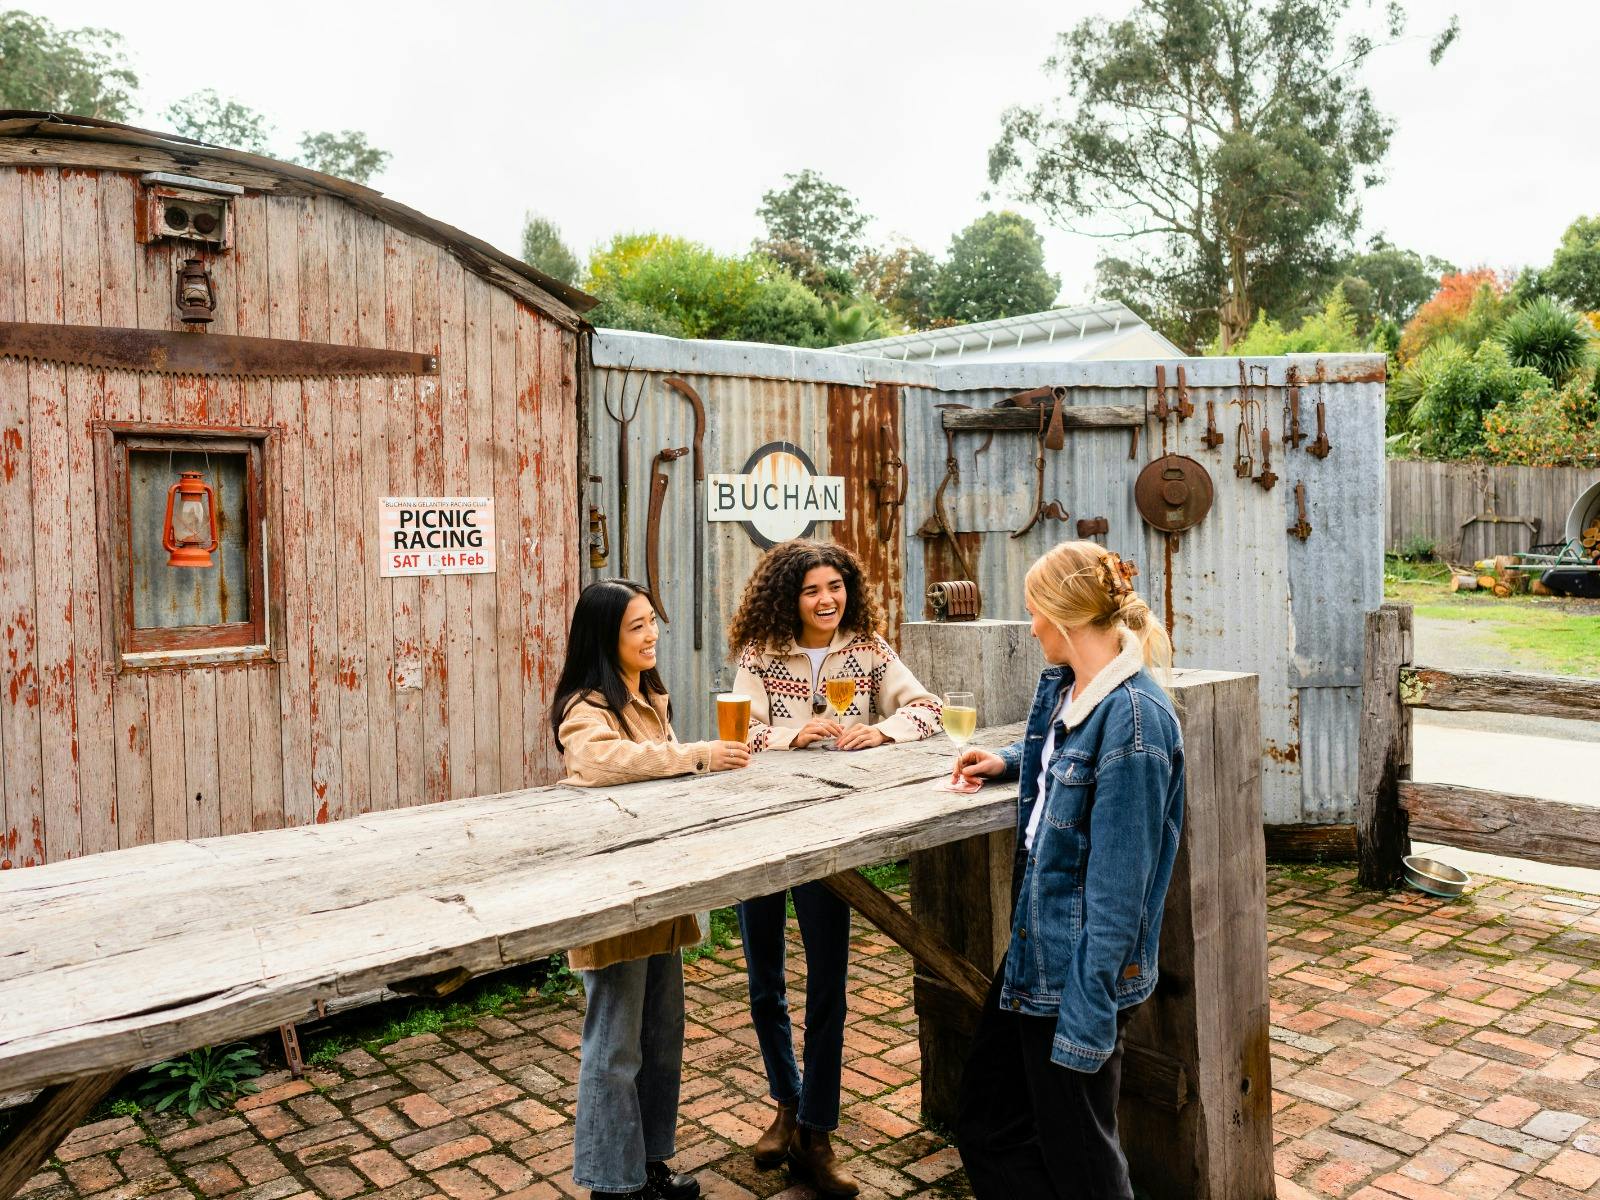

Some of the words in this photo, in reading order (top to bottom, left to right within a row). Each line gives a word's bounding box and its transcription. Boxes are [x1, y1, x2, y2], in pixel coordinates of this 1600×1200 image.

[718, 483, 838, 510] BUCHAN
[399, 510, 477, 528] PICNIC
[393, 530, 483, 549] RACING
[393, 554, 420, 568] SAT
[459, 552, 485, 566] Feb
